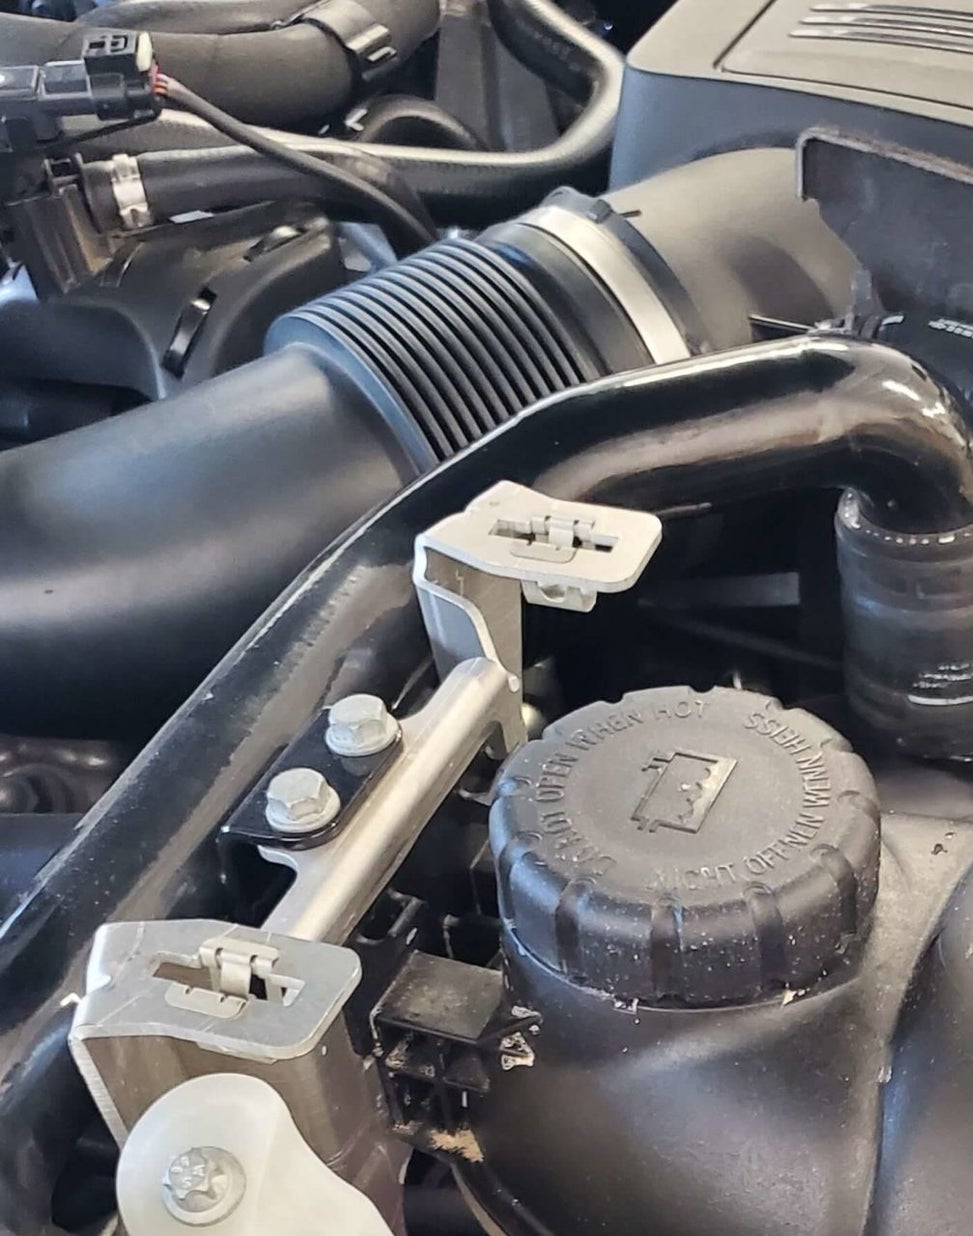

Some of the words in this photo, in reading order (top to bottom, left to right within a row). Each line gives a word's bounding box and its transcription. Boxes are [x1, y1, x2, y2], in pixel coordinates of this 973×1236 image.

[743, 711, 812, 756] HEISS
[535, 752, 579, 803] OPEN
[796, 751, 832, 809] WENN
